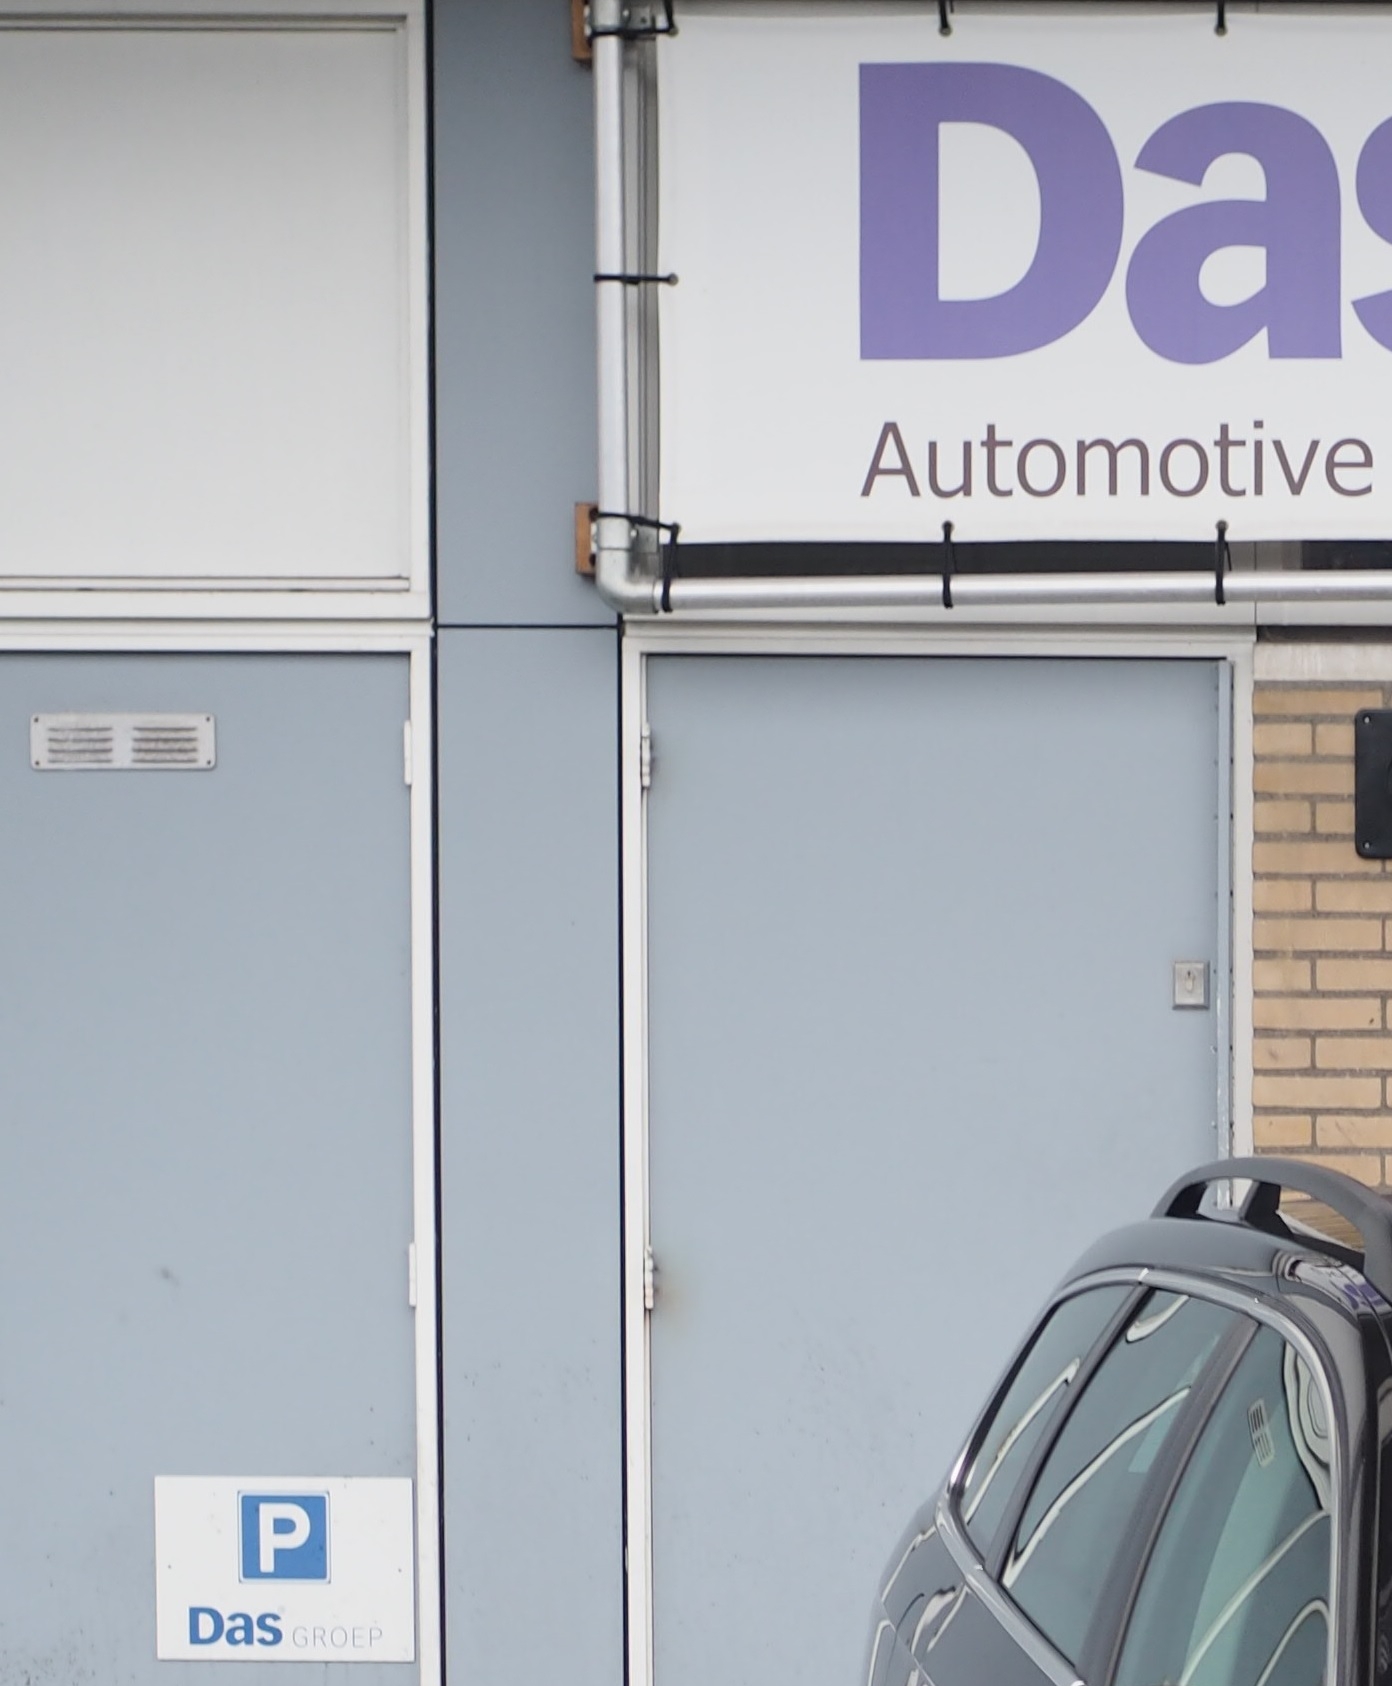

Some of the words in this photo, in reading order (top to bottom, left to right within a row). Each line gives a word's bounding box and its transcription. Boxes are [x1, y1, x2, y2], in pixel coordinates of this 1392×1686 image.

[860, 419, 1374, 499] Automotive
[258, 1502, 311, 1574] P
[188, 1606, 283, 1647] Das
[292, 1626, 383, 1649] GROEP
